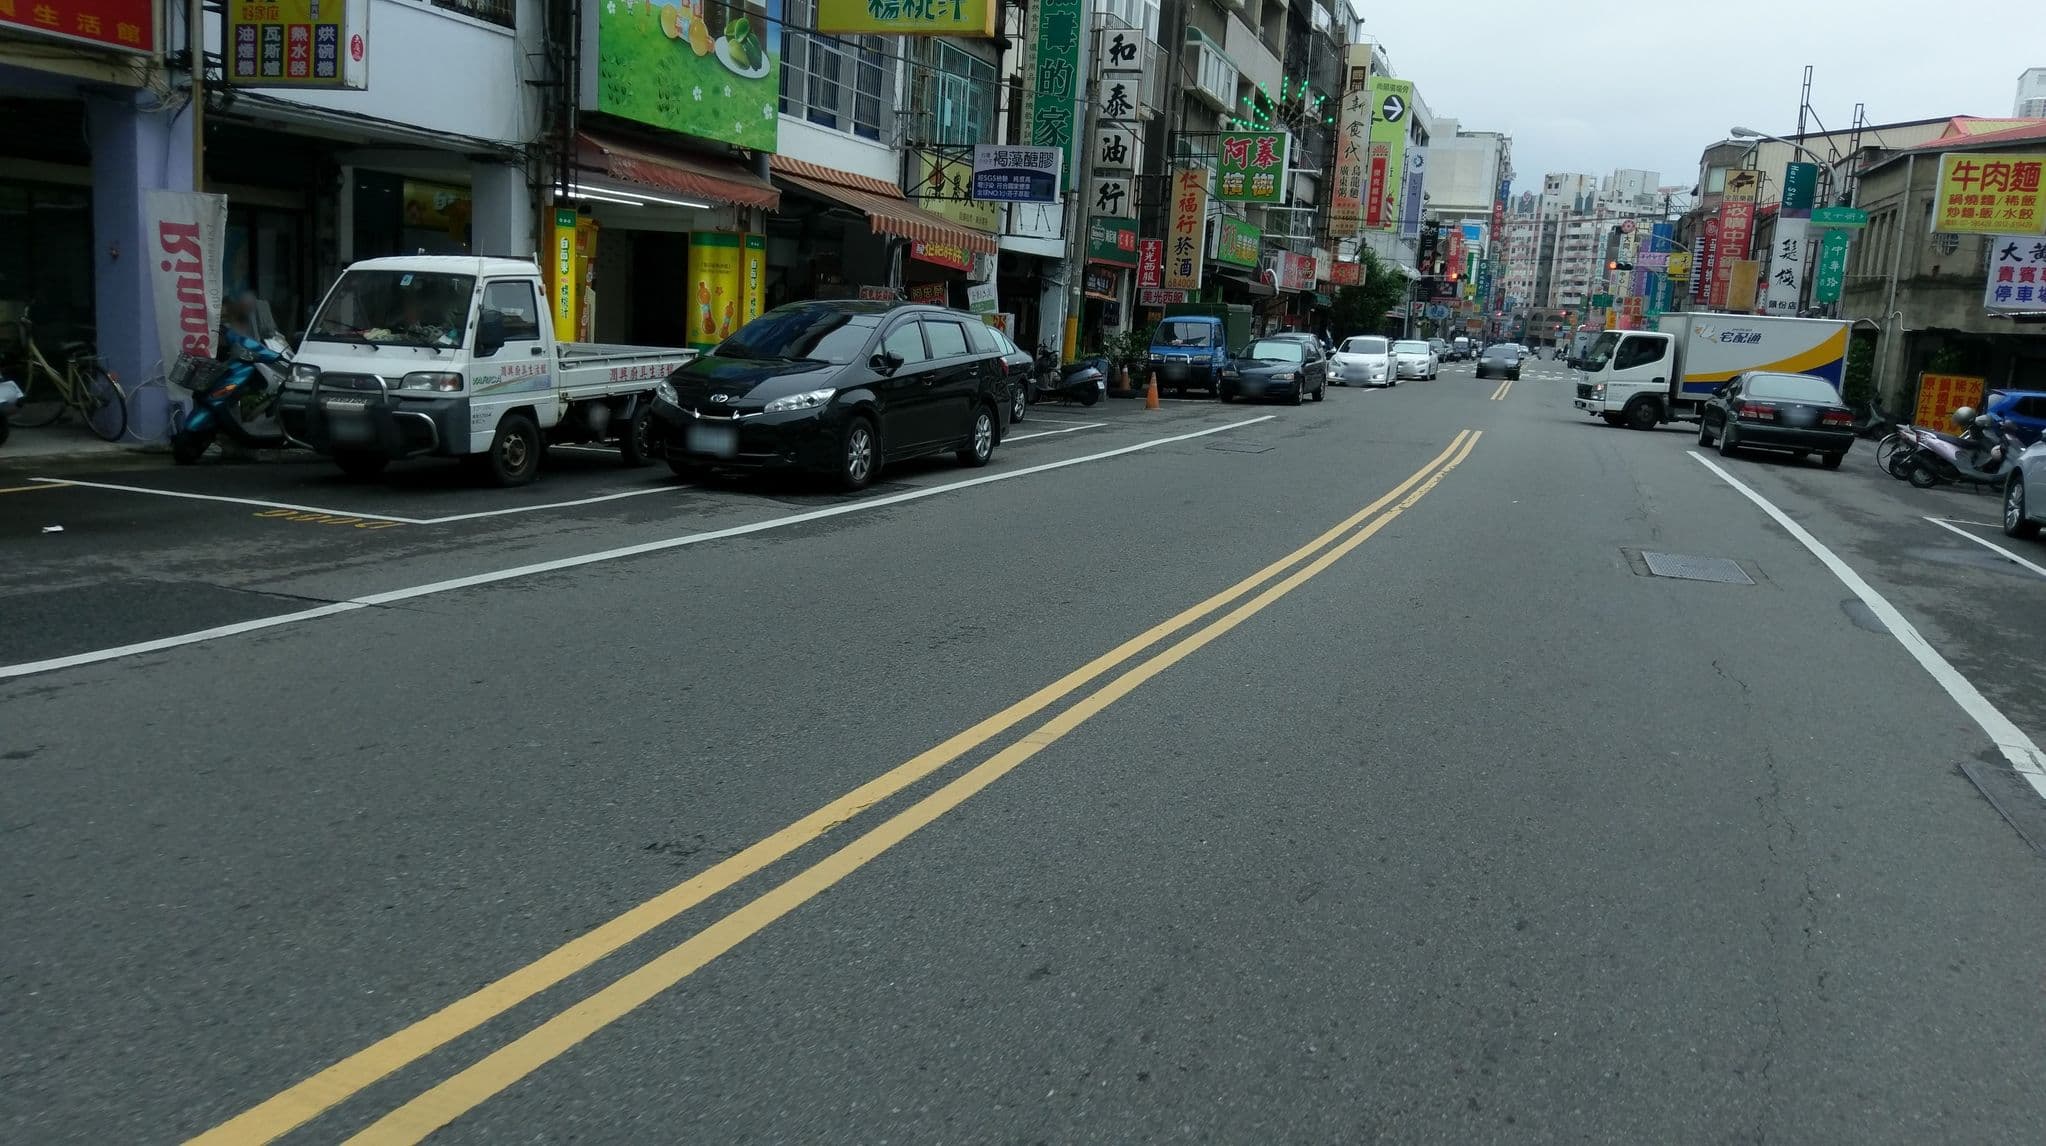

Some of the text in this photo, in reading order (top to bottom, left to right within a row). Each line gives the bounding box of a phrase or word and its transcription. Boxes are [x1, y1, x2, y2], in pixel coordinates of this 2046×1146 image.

[0, 0, 139, 42] 生活館
[1096, 33, 1137, 215] 和泰油行
[993, 150, 1054, 169] 褐藻醣膠
[1951, 159, 2043, 193] 牛肉麵
[1173, 171, 1201, 278] 仁福行菸酒
[1143, 241, 1157, 281] 美光西服
[1719, 331, 1763, 345] 宅配通
